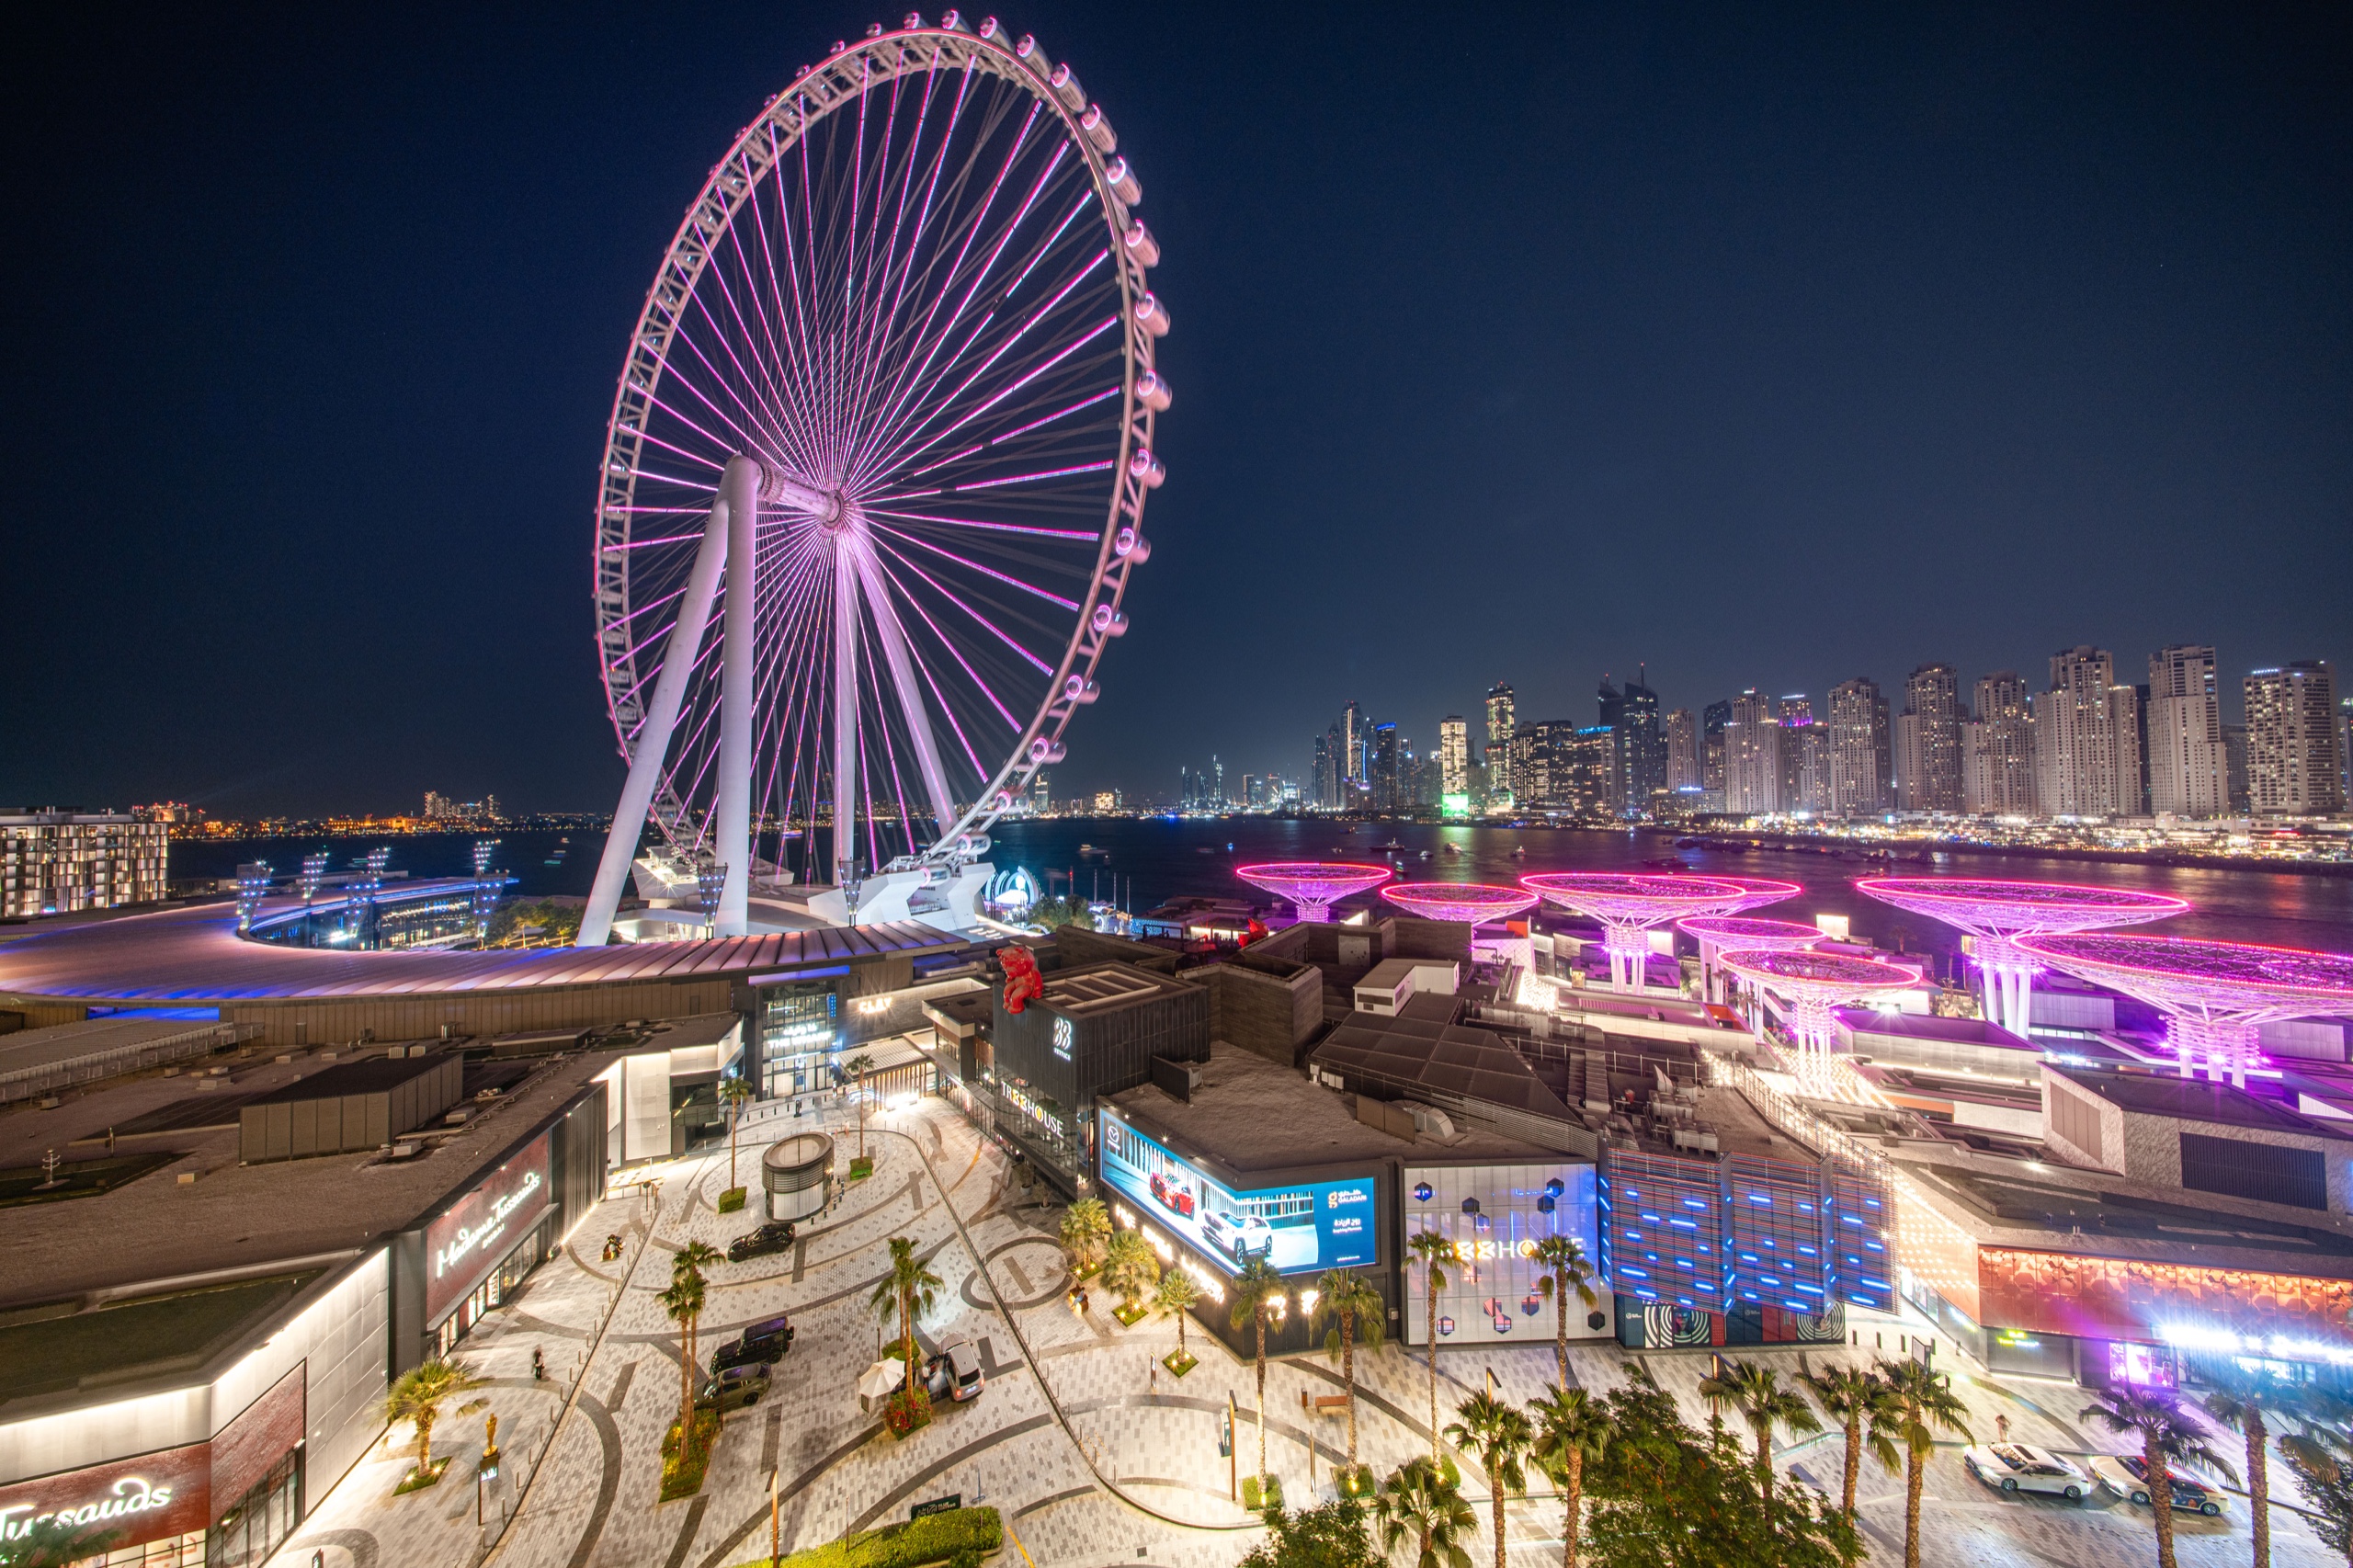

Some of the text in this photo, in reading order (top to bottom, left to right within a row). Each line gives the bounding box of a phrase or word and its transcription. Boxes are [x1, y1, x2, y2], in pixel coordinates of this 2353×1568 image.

[858, 997, 892, 1014] CLAY
[767, 1038, 790, 1049] THE
[1053, 1017, 1072, 1050] 88
[437, 1172, 540, 1278] Madame Tussauds
[482, 1223, 505, 1249] DUBAI
